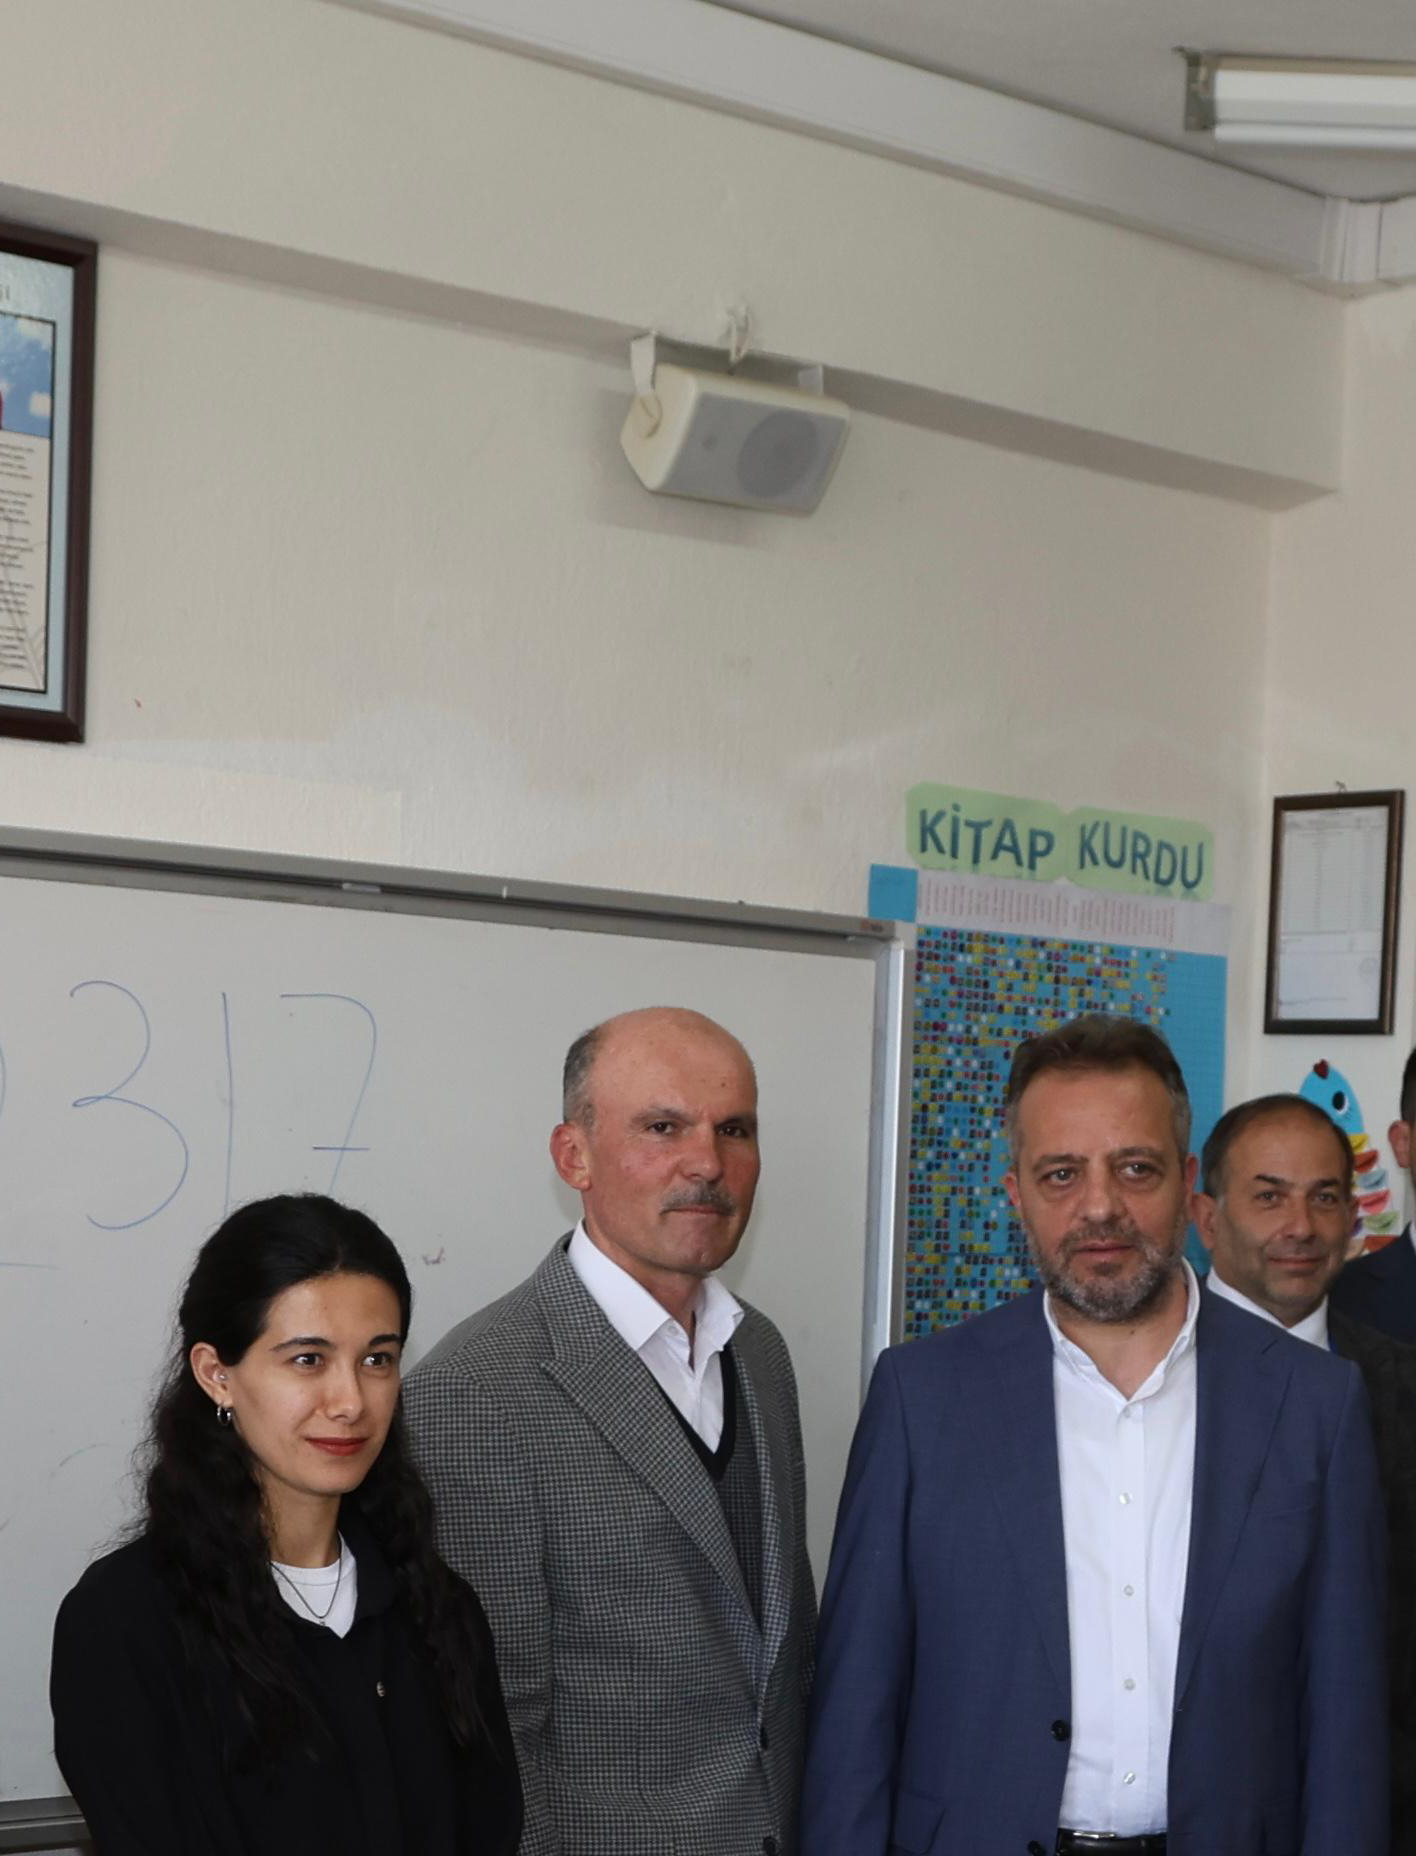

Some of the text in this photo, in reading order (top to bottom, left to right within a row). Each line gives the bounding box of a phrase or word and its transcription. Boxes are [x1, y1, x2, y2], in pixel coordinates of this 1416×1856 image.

[919, 803, 1056, 872] KİTAP
[1079, 820, 1204, 890] KURDU
[0, 981, 376, 1229] 317
